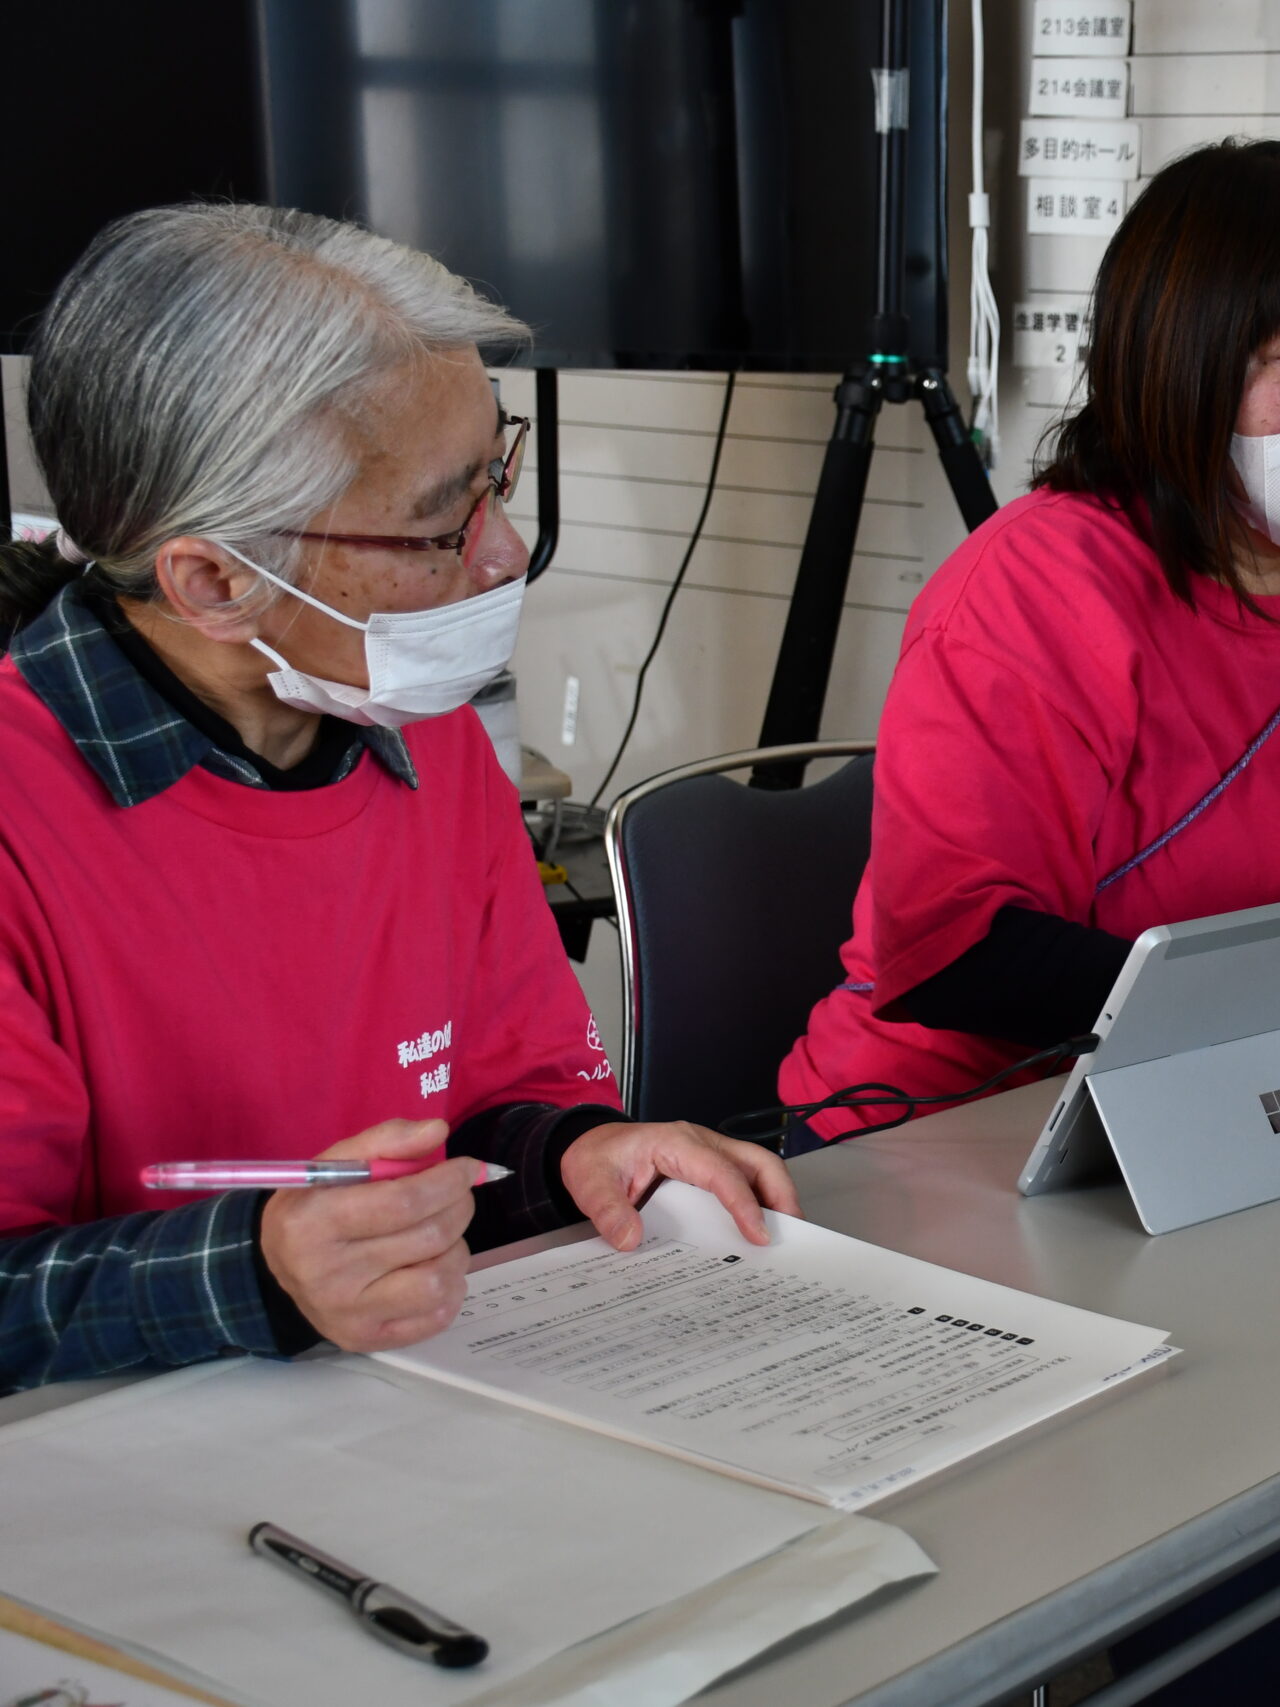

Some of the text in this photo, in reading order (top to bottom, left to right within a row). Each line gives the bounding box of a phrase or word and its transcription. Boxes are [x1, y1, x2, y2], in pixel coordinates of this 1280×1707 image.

[1040, 16, 1125, 38] 213会議室
[1037, 78, 1122, 100] 214会議室
[1023, 137, 1134, 162] 多目的ホール
[1036, 195, 1118, 220] 相談室4
